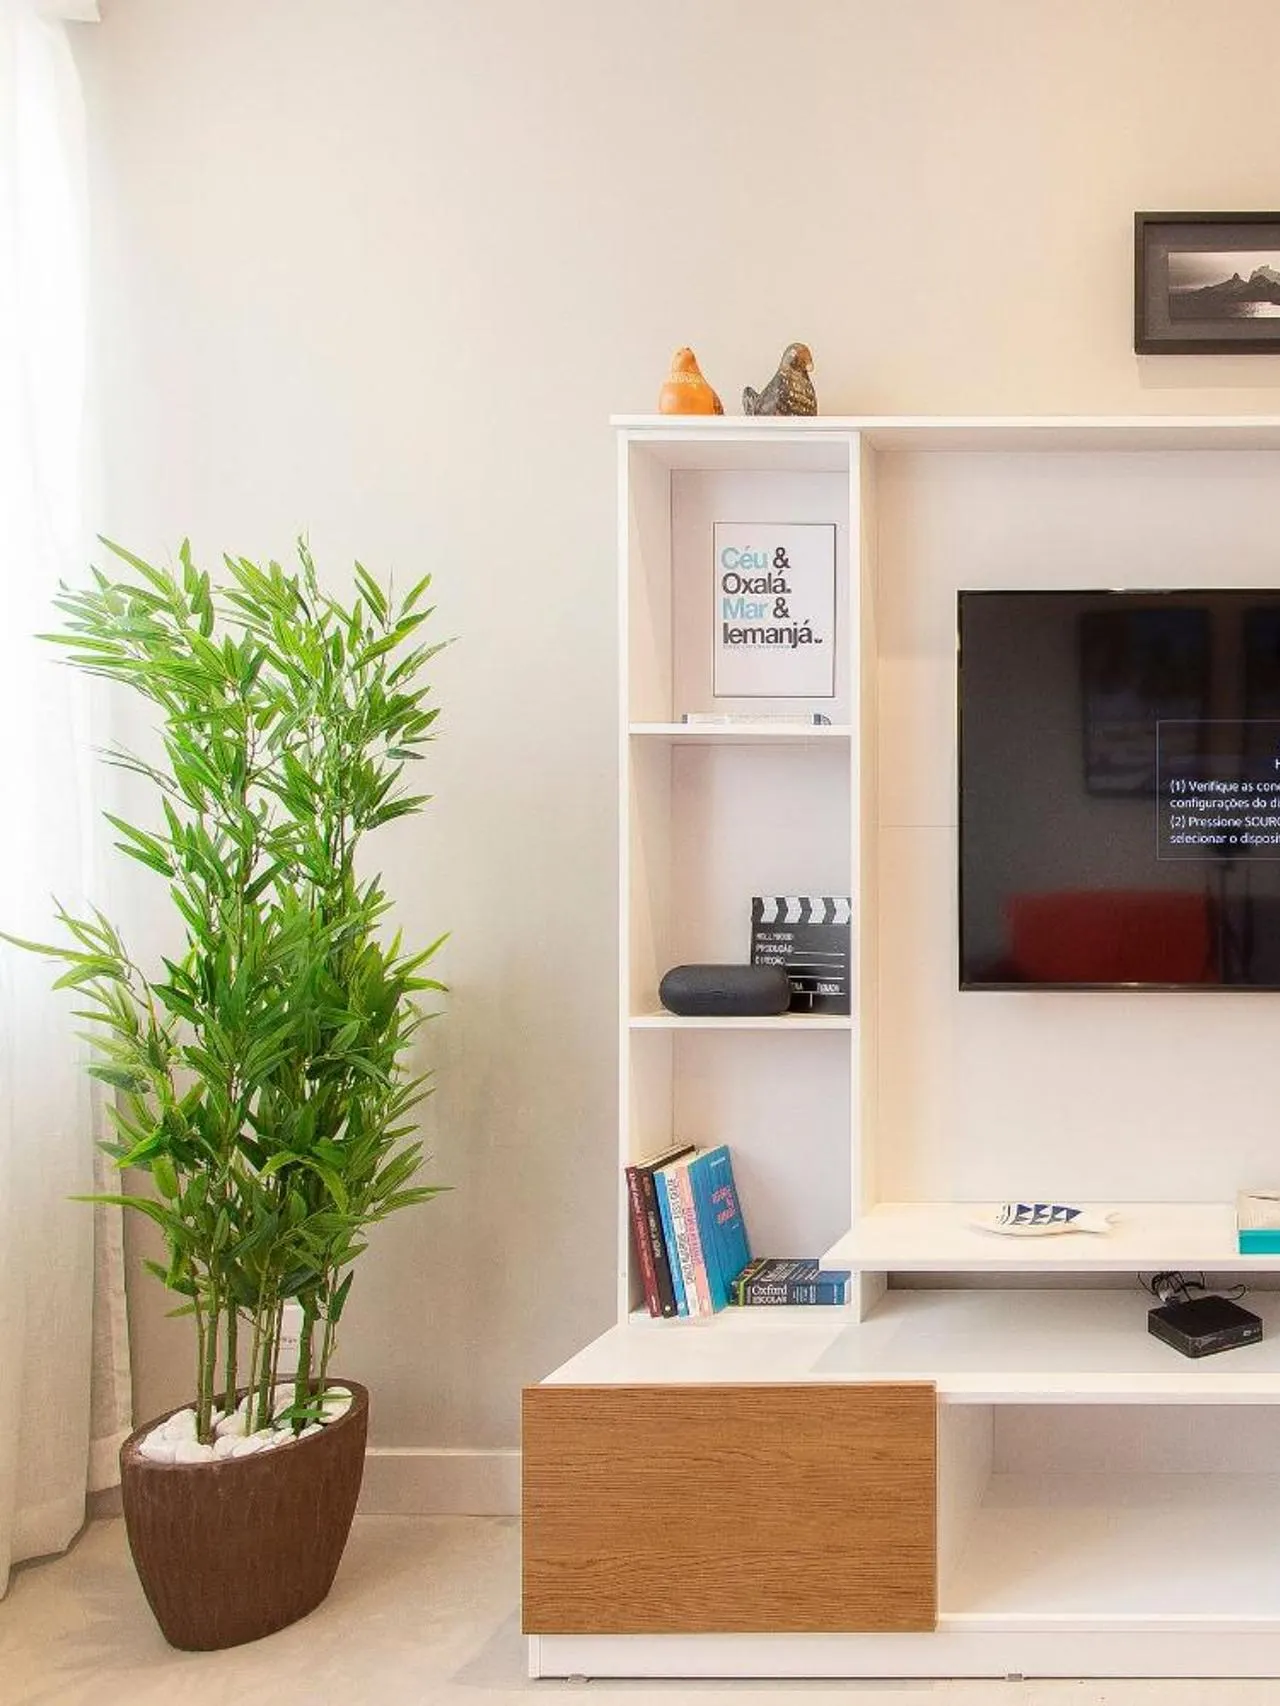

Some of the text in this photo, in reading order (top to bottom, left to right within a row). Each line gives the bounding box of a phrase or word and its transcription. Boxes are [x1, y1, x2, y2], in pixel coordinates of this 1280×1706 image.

[721, 545, 791, 569] Céu &
[722, 570, 792, 595] Oxalá.
[723, 597, 790, 620] Mar &
[1170, 780, 1186, 794] (1)
[1188, 780, 1239, 794] Verifique
[1241, 783, 1254, 793] as
[1170, 797, 1250, 811] configurações
[1252, 797, 1267, 808] do
[1170, 815, 1185, 829] (2)
[1188, 816, 1243, 827] Pressione
[1170, 832, 1227, 844] selecionar
[1229, 834, 1238, 844] o
[752, 1284, 787, 1296] Oxford
